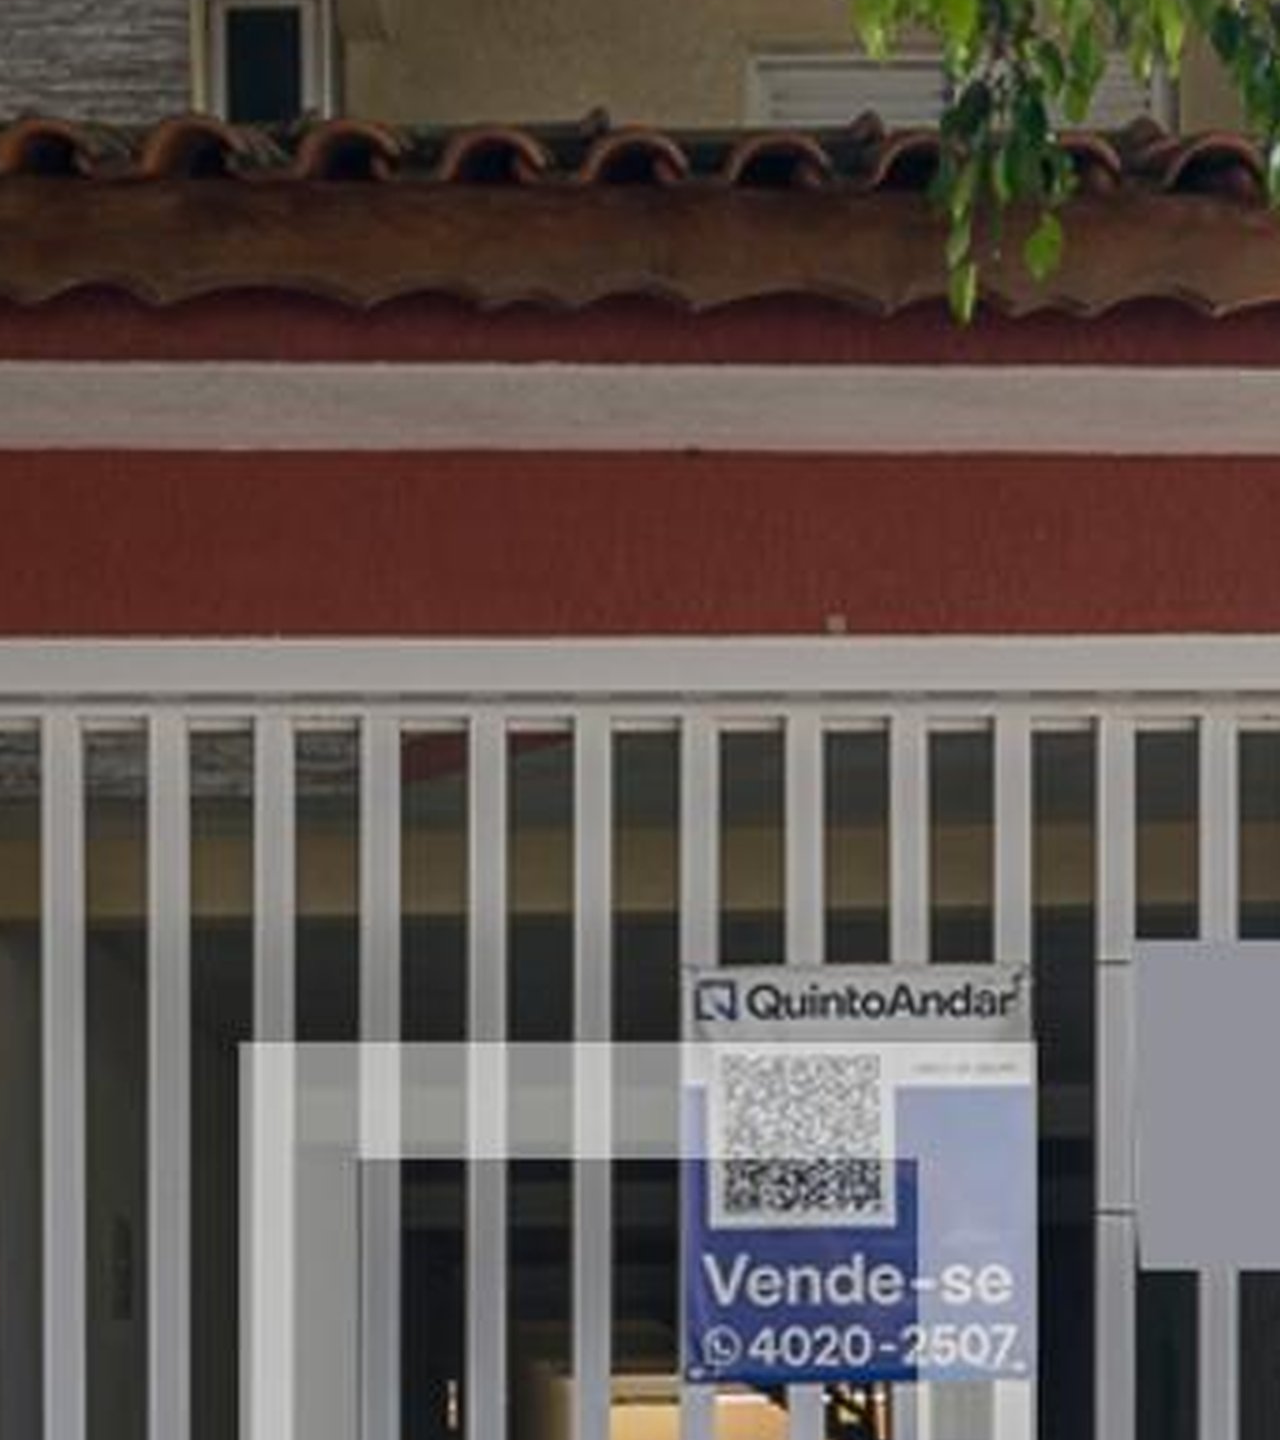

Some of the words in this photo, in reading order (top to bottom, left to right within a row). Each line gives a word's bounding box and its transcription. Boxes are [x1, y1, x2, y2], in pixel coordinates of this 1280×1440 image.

[747, 983, 1017, 1020] QuintoAndar
[703, 1252, 1014, 1307] Vende-se
[748, 1325, 1018, 1368] 4020-2507
